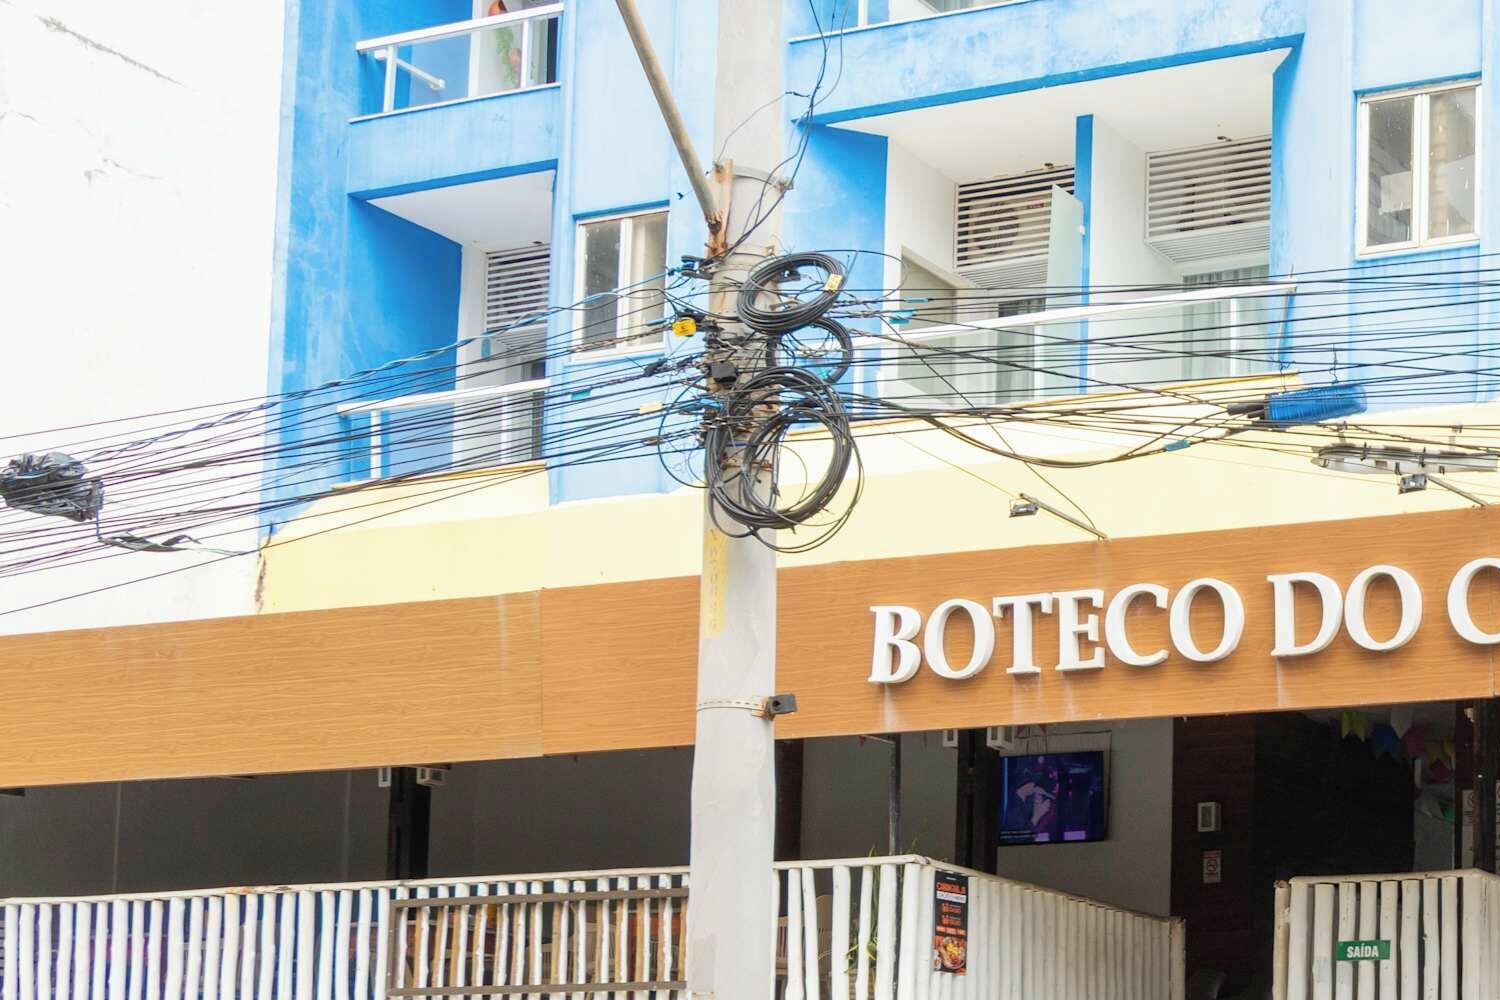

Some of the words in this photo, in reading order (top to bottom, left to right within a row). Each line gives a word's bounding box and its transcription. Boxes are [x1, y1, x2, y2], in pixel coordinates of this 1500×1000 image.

[868, 577, 1245, 684] BOTECO
[1266, 564, 1423, 657] DO
[1346, 942, 1379, 959] SAÍDA
